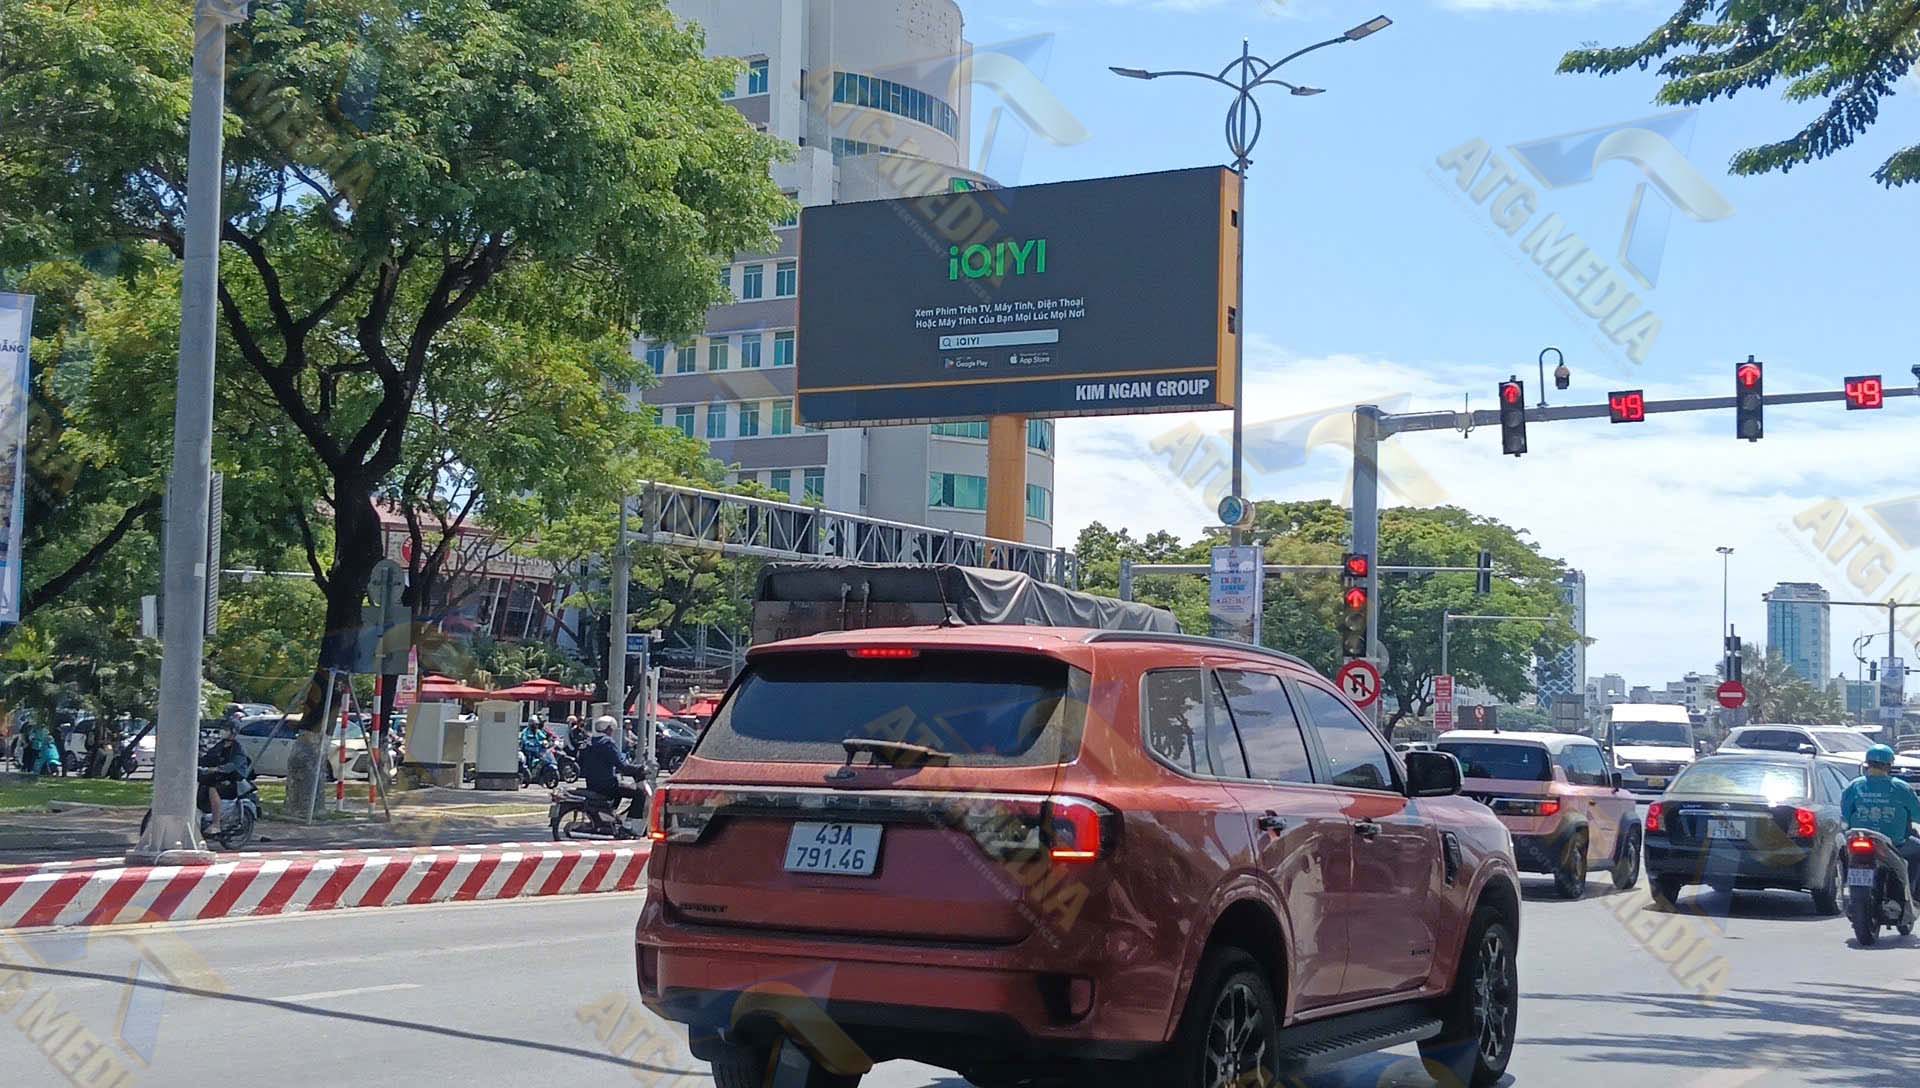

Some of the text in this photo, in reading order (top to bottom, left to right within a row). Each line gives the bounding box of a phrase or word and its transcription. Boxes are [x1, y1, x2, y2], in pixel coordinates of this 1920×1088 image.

[948, 239, 1047, 281] iQIYI
[915, 308, 934, 318] Xem
[935, 306, 957, 316] Phim
[958, 304, 978, 314] Trên
[979, 304, 992, 313] TV,
[978, 313, 995, 325] Của
[955, 360, 976, 368] Google
[976, 359, 989, 368] Play
[1019, 357, 1033, 365] App
[1075, 379, 1210, 401] KIM NGAN GROUP
[1846, 379, 1880, 406] 49
[1611, 393, 1644, 420] 49
[815, 824, 853, 846] 43A
[796, 846, 866, 870] 791.46
